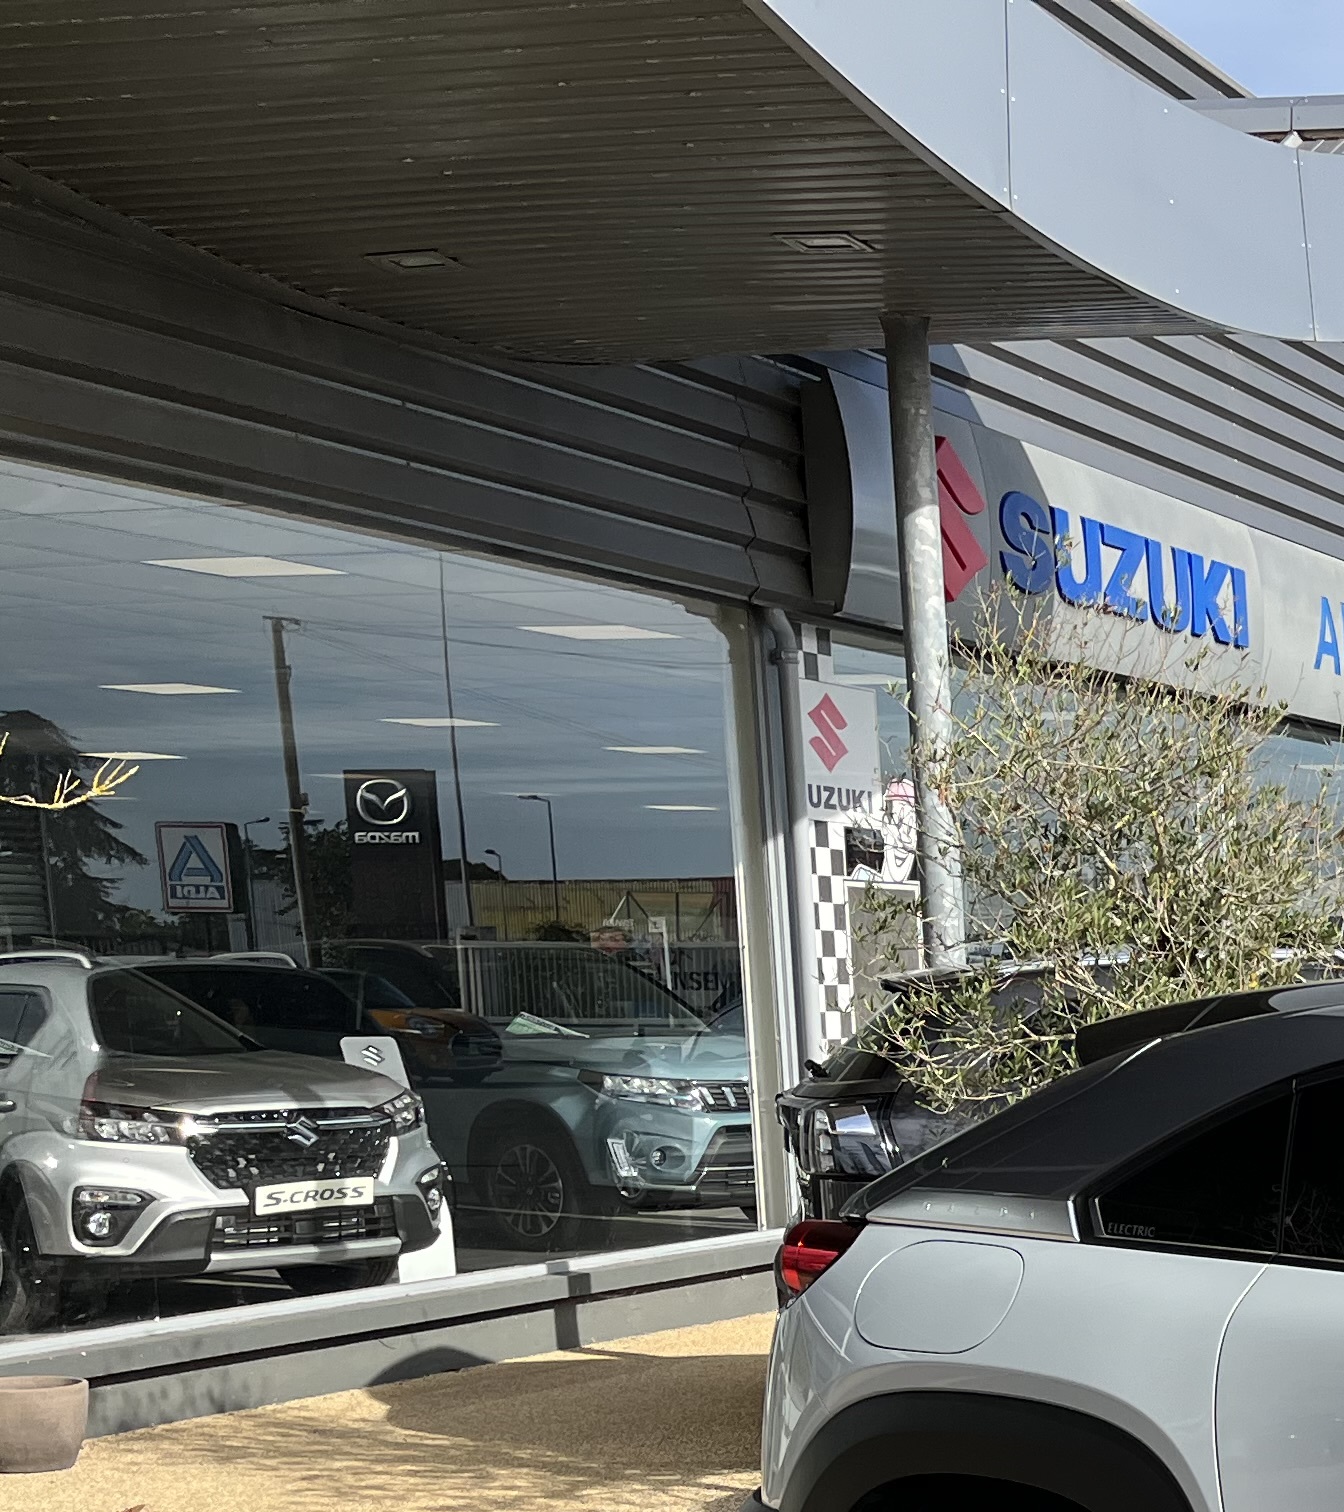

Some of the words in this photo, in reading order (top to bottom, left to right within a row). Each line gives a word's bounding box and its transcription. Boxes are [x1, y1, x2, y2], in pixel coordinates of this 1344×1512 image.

[999, 490, 1250, 650] SUZUKI
[807, 783, 873, 814] UZUKI
[1107, 1222, 1156, 1237] ELECTRIC
